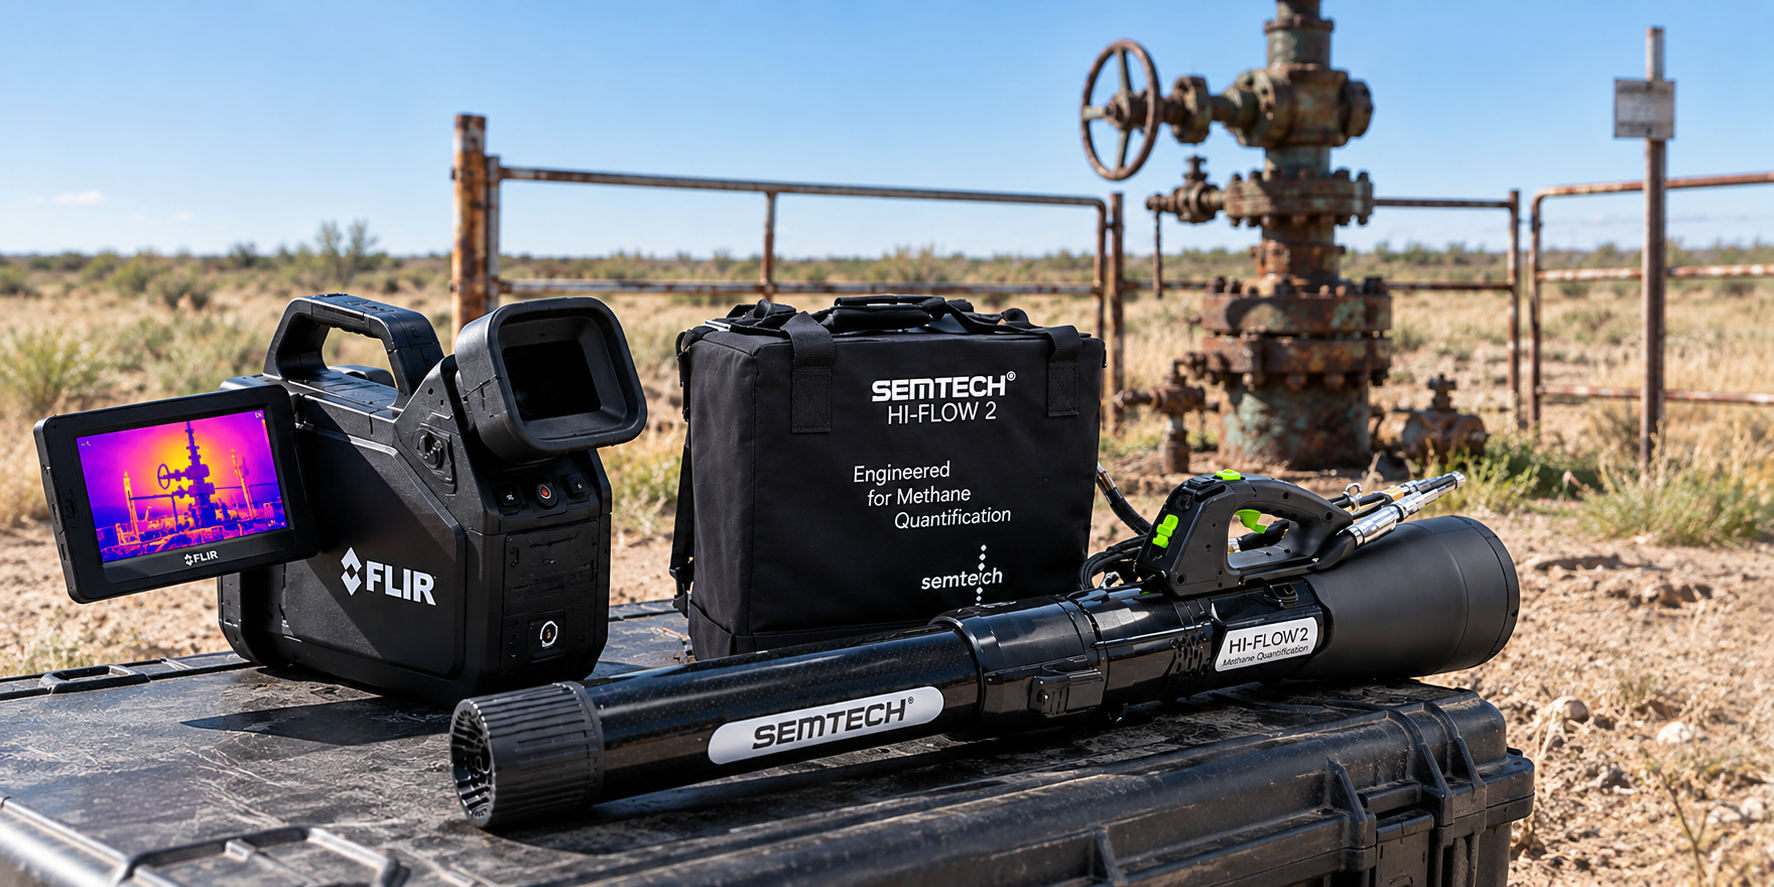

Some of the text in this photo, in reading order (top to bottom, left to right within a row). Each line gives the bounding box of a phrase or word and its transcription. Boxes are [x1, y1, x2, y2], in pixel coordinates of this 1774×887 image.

[888, 401, 997, 425] HI-FLOW 2
[853, 460, 951, 486] Engineered
[867, 486, 971, 506] for Methane
[894, 507, 1012, 529] Quantification
[193, 550, 219, 564] FLIR
[366, 560, 437, 607] FLIR
